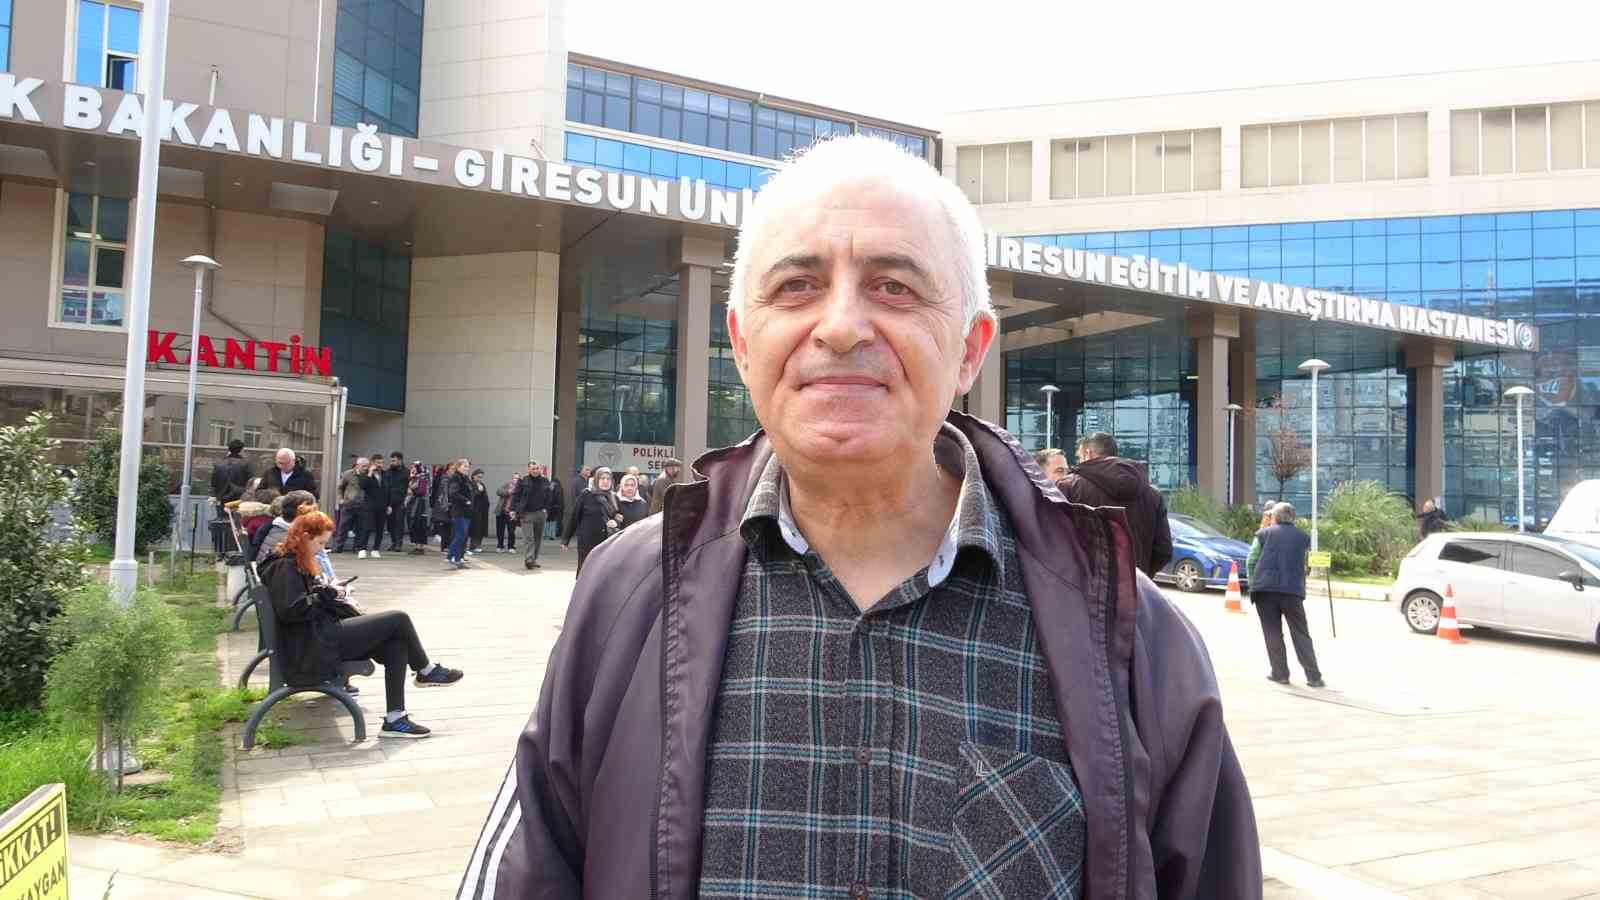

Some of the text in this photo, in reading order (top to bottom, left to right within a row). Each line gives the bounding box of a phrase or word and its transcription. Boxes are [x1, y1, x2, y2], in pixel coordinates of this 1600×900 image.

[64, 84, 403, 176] BAKANLIĞI
[455, 145, 669, 216] GİRESUN
[1112, 253, 1210, 299] EĞİTİM
[1216, 273, 1250, 305] VE
[1255, 280, 1396, 328] ARAŞTIRMA
[1400, 304, 1515, 347] HASTANESİ
[148, 329, 333, 376] KANTİN
[17, 856, 65, 900] AYGAN
